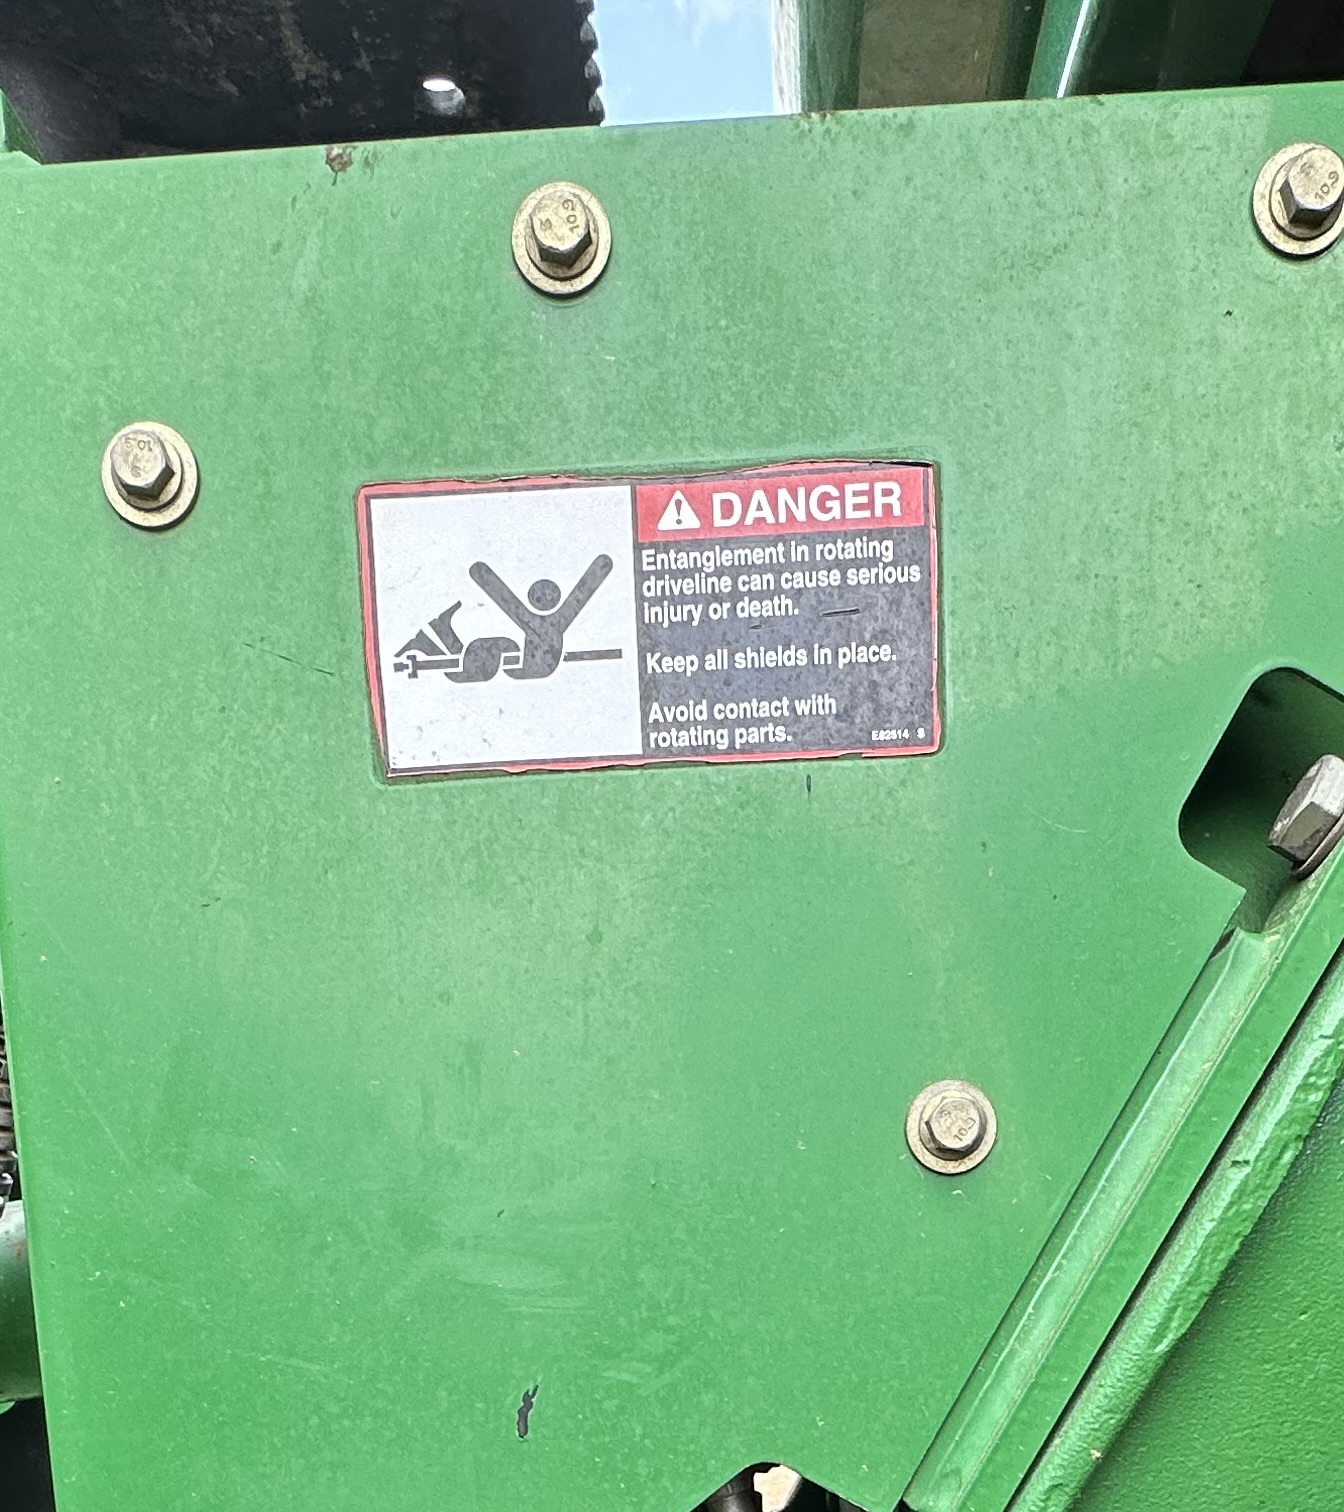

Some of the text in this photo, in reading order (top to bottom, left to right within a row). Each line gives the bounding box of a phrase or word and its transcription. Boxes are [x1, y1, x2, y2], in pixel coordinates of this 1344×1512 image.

[711, 481, 903, 528] DANGER
[641, 535, 895, 573] Entanglement in rotating
[642, 561, 922, 598] driveline can cause serious
[643, 593, 800, 629] injury or death.
[645, 640, 898, 678] Keep all shields in place.
[647, 692, 838, 724] Avoid contact with
[648, 721, 794, 750] rotating parts.
